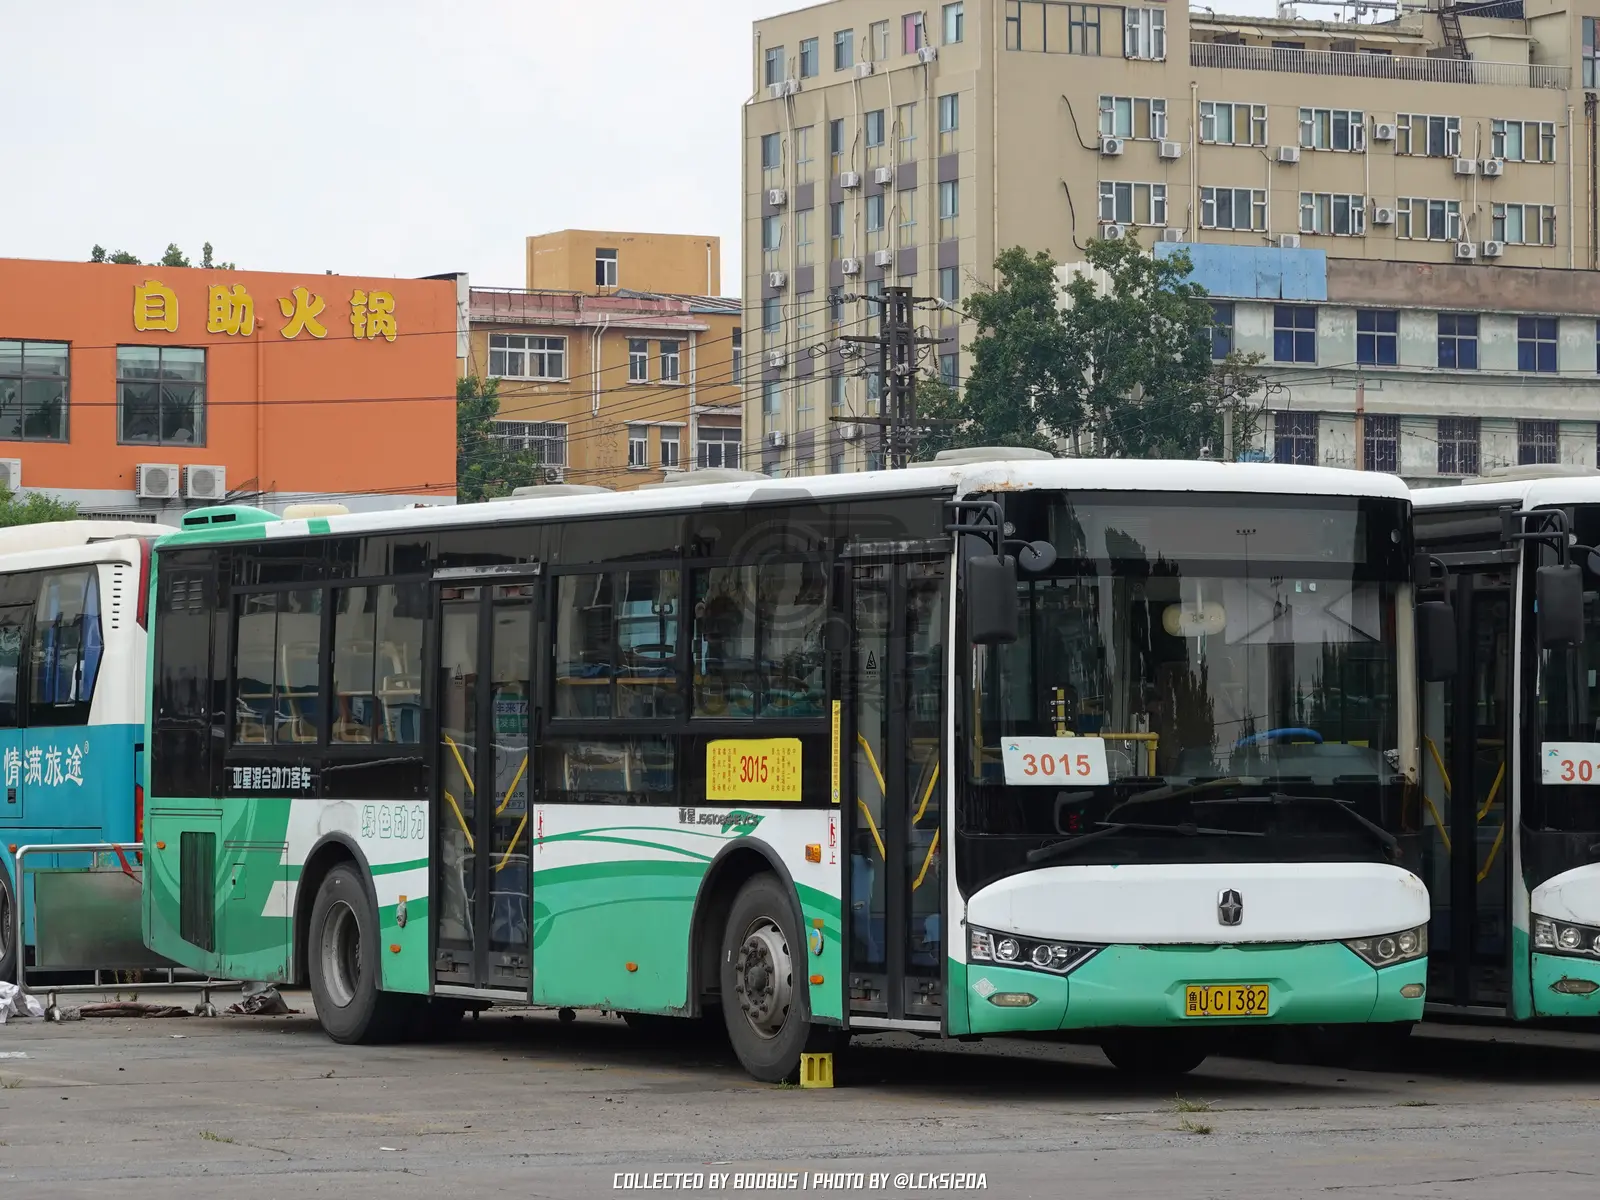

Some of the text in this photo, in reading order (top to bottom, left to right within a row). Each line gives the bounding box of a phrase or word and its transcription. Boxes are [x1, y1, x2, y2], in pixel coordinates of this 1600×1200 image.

[133, 279, 397, 342] 自助火锅
[739, 755, 768, 783] 3015
[1022, 753, 1091, 777] 3015
[1560, 759, 1600, 782] 30
[233, 766, 311, 790] 亚星混合动力客车
[361, 804, 425, 840] 绿色动力
[829, 851, 837, 865] 上
